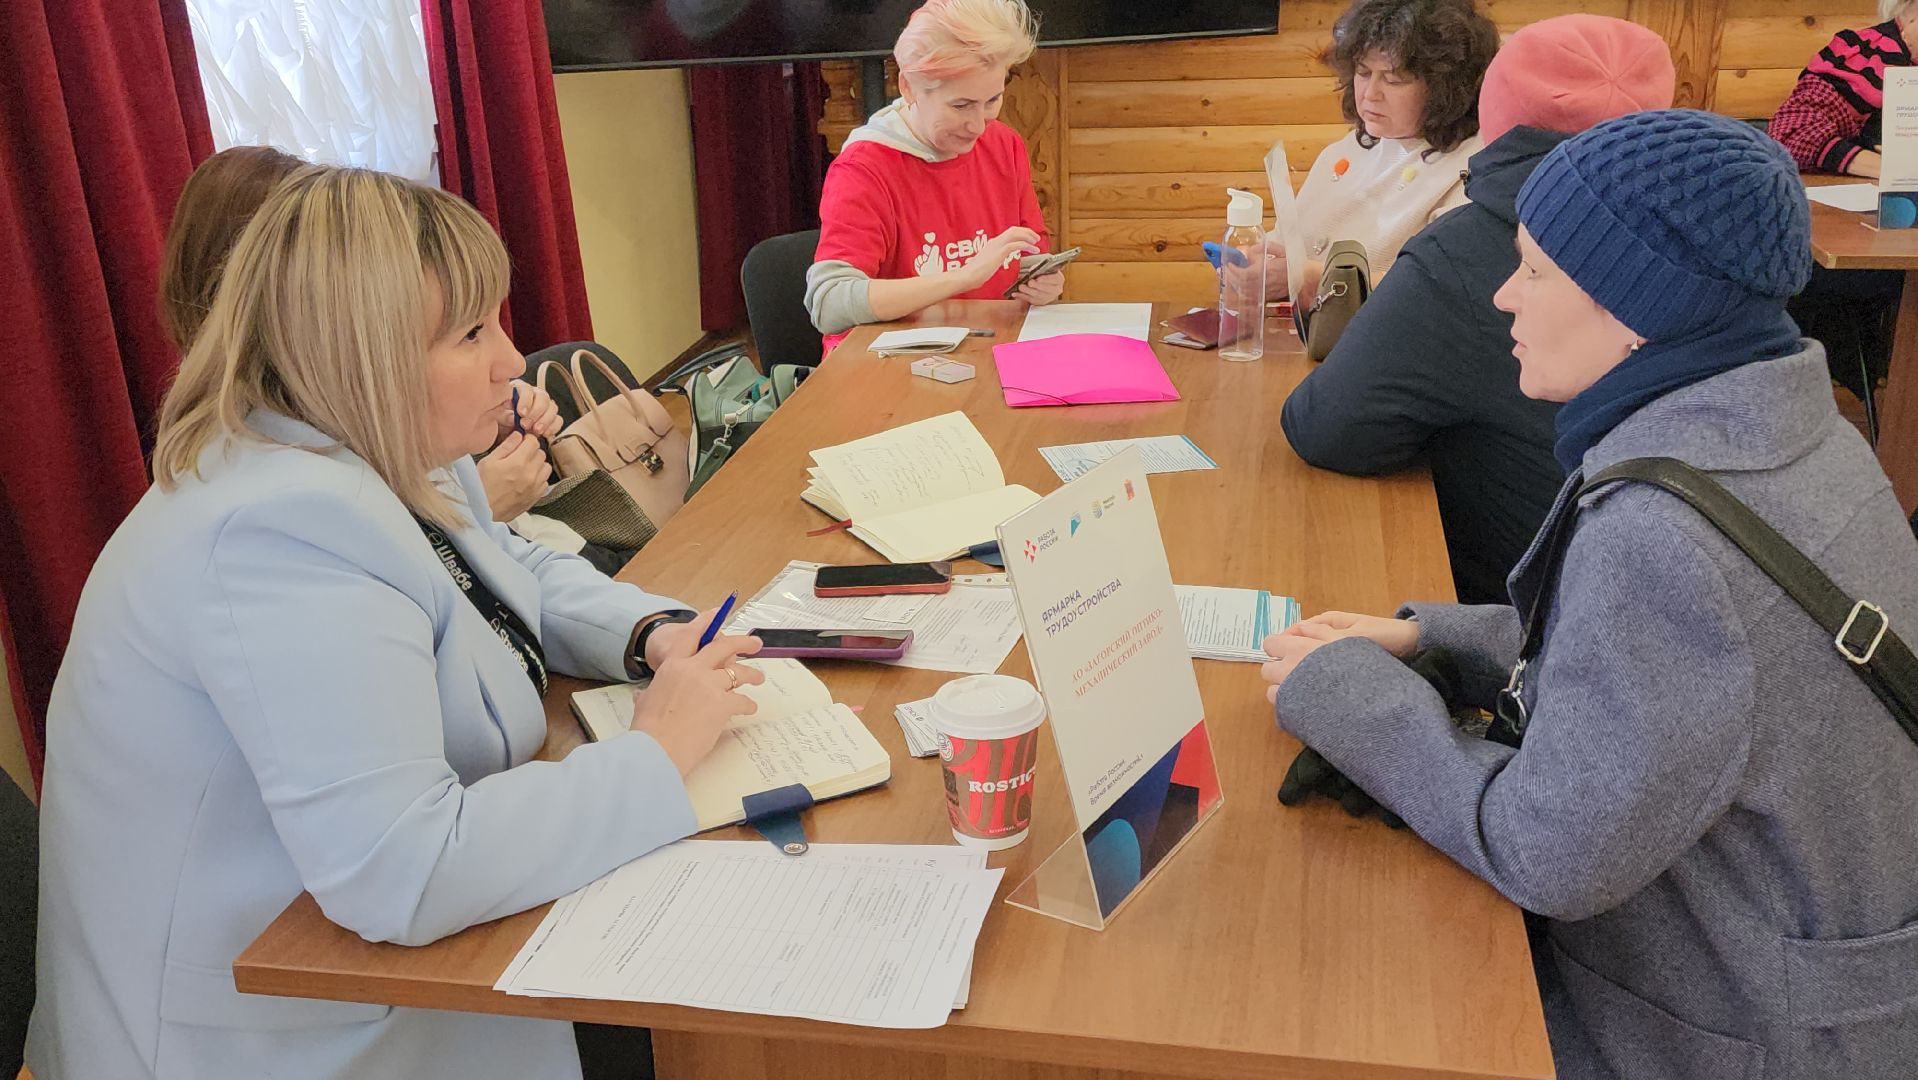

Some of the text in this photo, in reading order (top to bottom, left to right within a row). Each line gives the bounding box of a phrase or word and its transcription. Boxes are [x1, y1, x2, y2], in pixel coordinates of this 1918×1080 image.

[436, 544, 473, 591] Швабе
[1042, 589, 1081, 623] ЯРМАРКА
[1045, 578, 1122, 638] ТРУДОУСТРОЙСТВА
[1075, 643, 1138, 697] МЕХАНИЧЕСКИЙ
